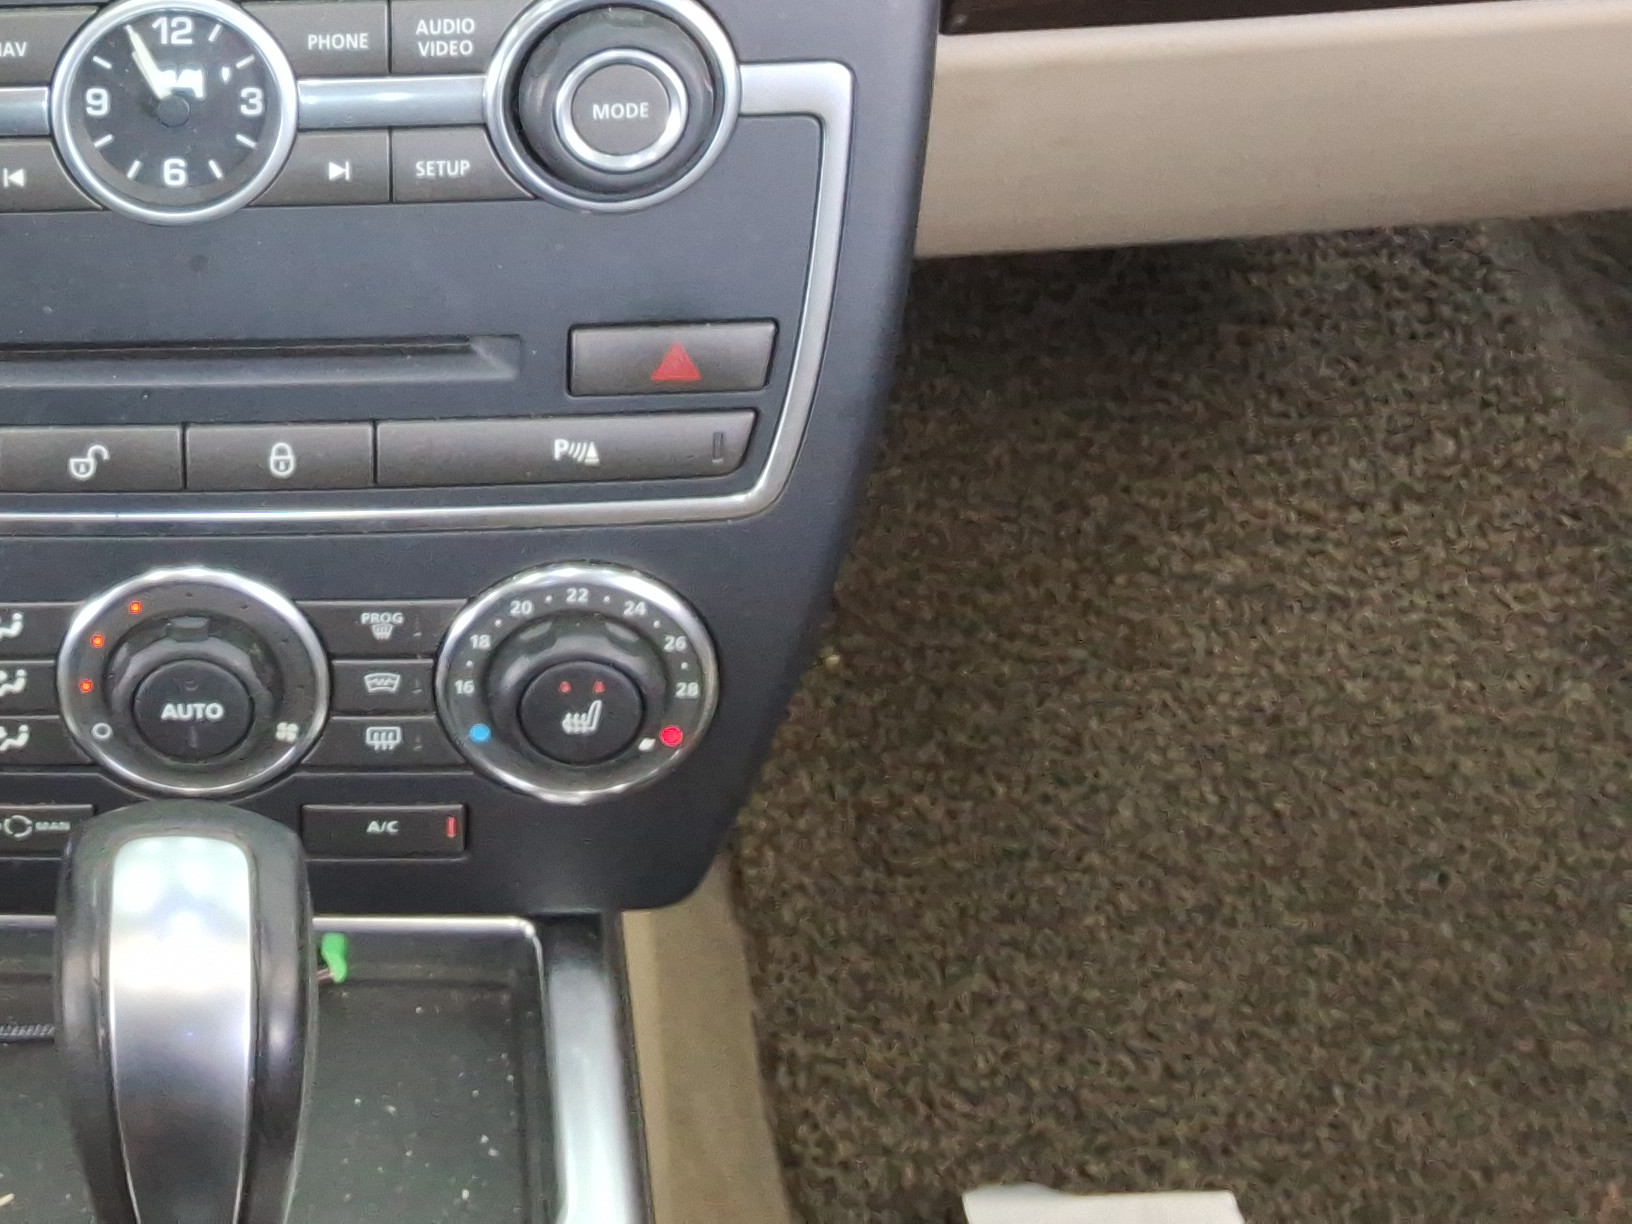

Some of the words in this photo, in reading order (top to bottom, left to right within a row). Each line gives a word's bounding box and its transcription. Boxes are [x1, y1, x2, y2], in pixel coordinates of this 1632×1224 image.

[152, 16, 194, 45] 12
[415, 17, 476, 36] AUDIO
[307, 32, 369, 51] PHONE
[417, 38, 474, 57] VIDEO
[85, 87, 110, 116] 9
[239, 86, 264, 116] 3
[592, 101, 650, 120] MODE
[162, 157, 188, 187] 6
[415, 159, 471, 178] SETUP
[566, 588, 589, 603] 22
[509, 600, 533, 616] 20
[623, 600, 647, 617] 24
[361, 612, 404, 625] PROG
[469, 634, 491, 650] 18
[664, 635, 687, 652] 26
[454, 680, 475, 695] 16
[675, 682, 699, 698] 28
[161, 702, 225, 721] AUTO
[366, 820, 400, 834] A/C
